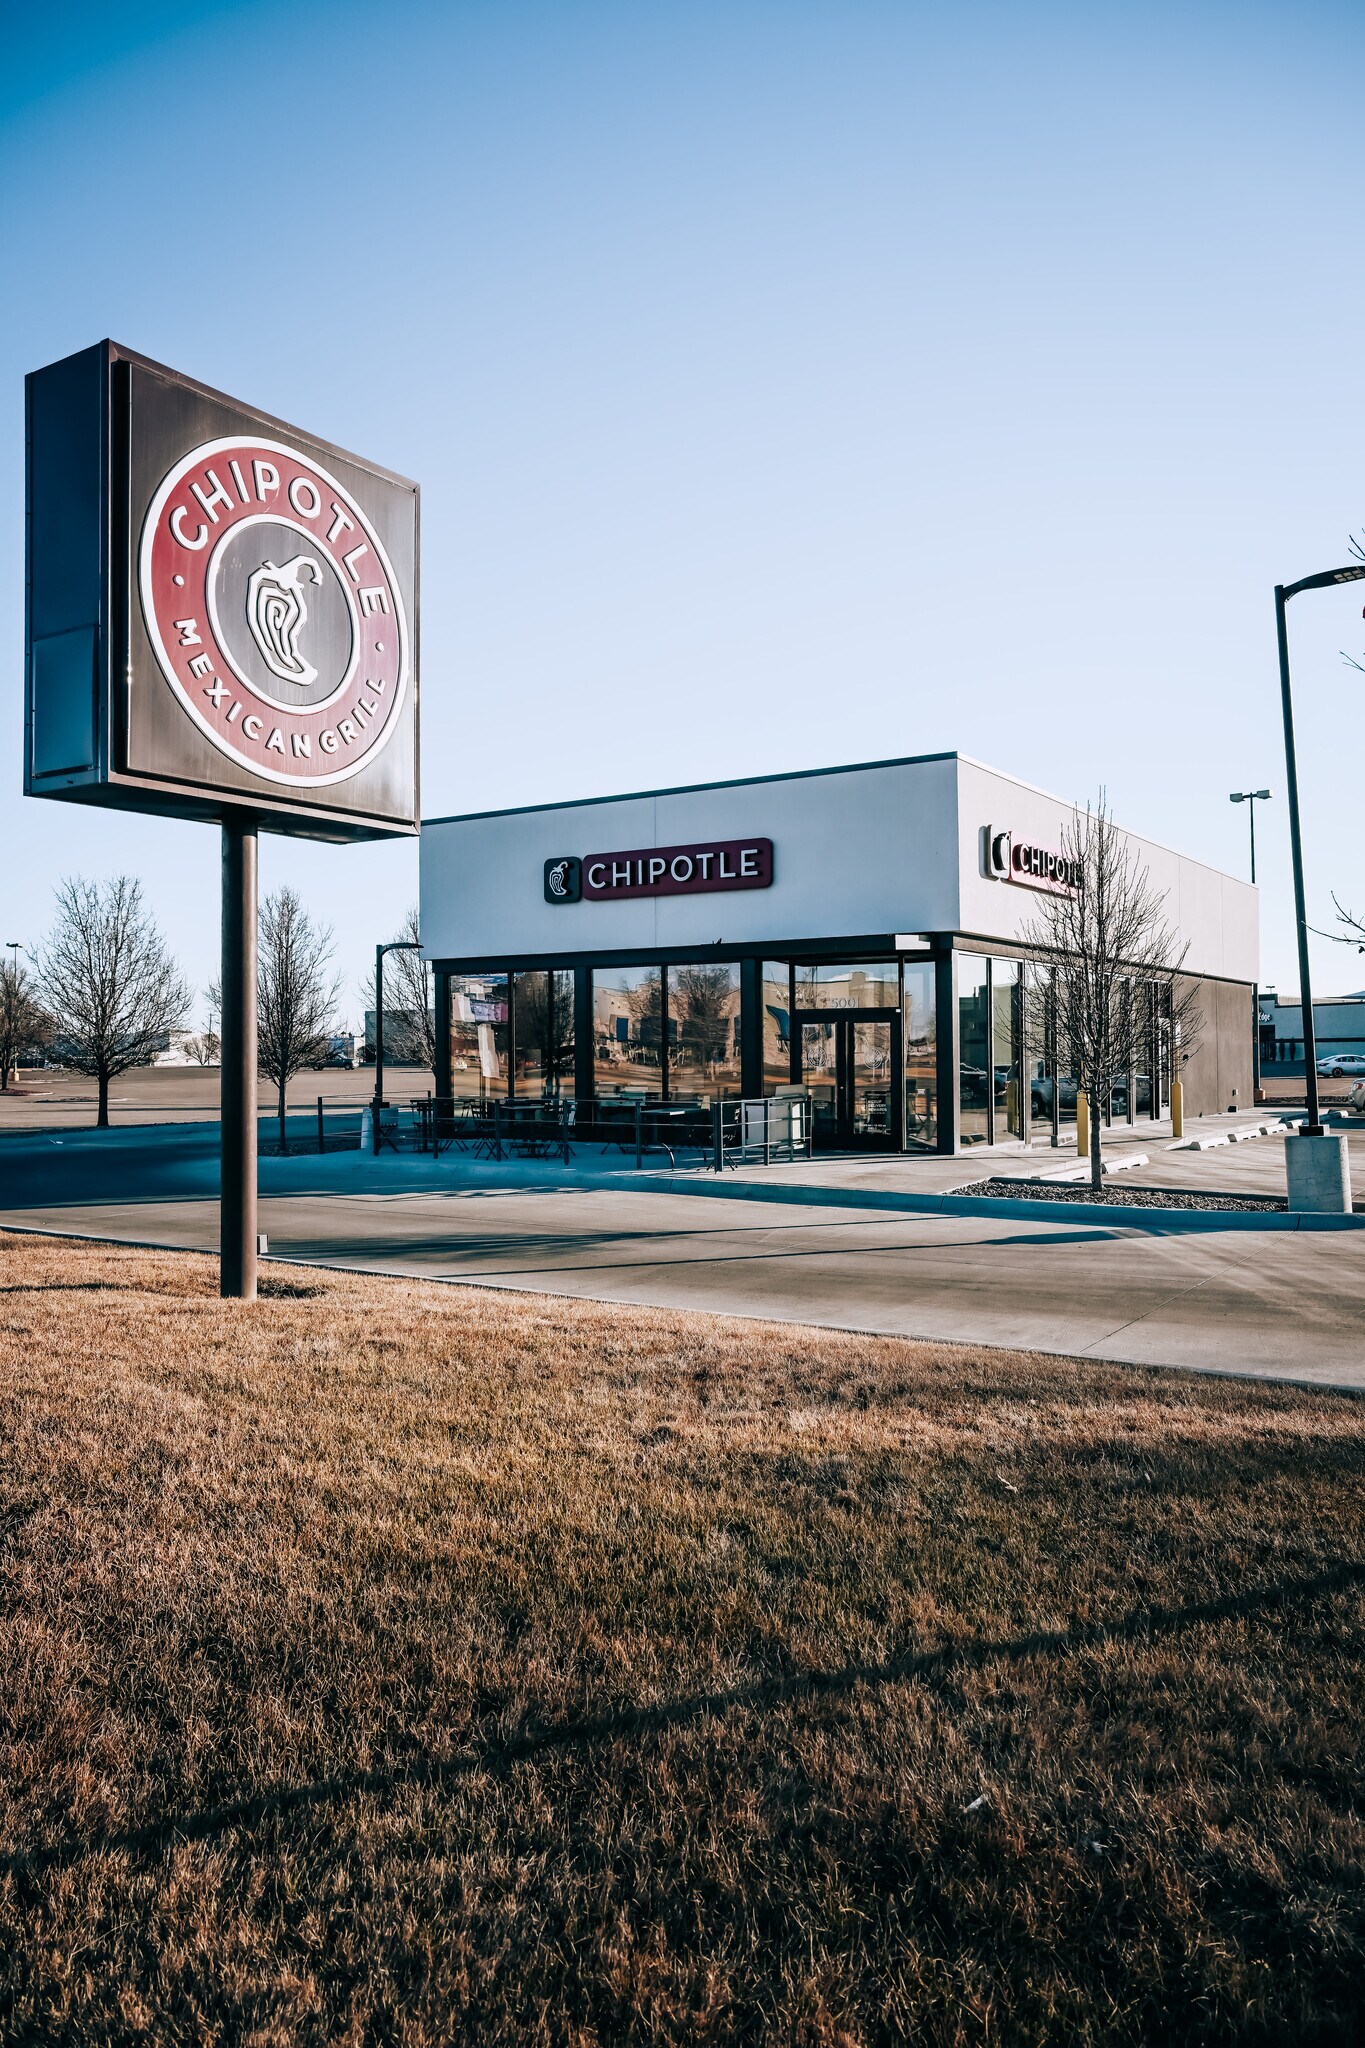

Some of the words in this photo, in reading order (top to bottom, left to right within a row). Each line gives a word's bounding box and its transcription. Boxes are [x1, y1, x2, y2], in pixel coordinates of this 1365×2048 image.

[170, 460, 391, 618] CHIPOTLE
[174, 618, 313, 759] MEXICAN
[319, 677, 388, 755] GRILL
[588, 849, 759, 890] CHIPOTLE
[1020, 843, 1084, 887] CHIPOTL
